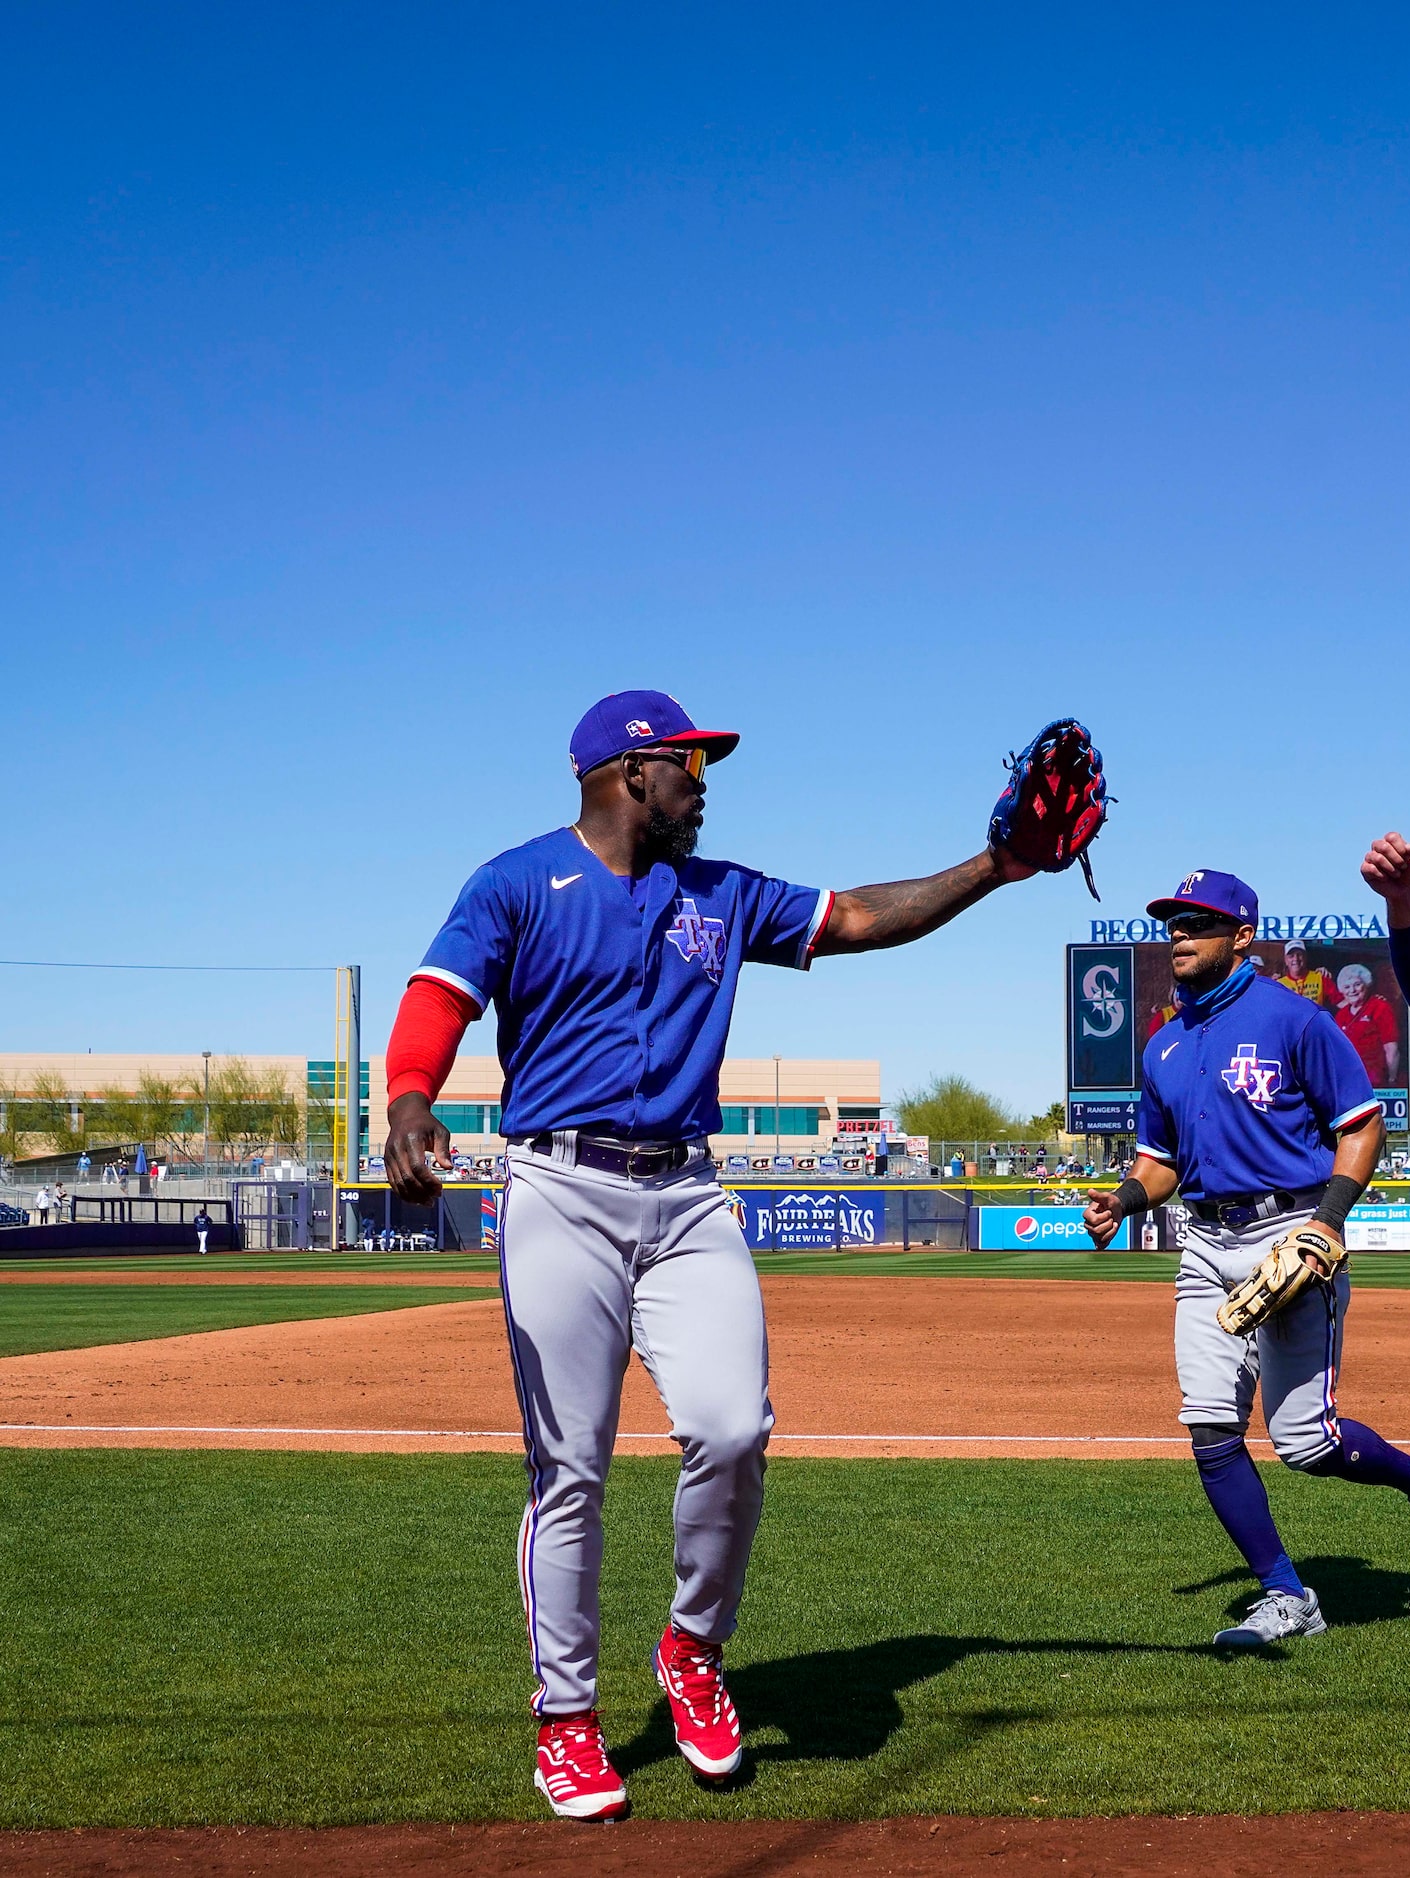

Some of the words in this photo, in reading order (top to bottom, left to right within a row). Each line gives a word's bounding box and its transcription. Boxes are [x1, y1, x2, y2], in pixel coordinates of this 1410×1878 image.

[1180, 872, 1205, 895] T
[1090, 919, 1170, 943] PEOR
[1087, 1106, 1121, 1114] RANGERS
[1126, 1102, 1135, 1114] 4
[836, 1120, 896, 1134] PRETZEL
[1126, 1118, 1135, 1130] 0
[340, 1191, 360, 1201] 340
[1360, 1209, 1387, 1219] grass
[1388, 1208, 1407, 1219] just
[757, 1208, 809, 1242] FOUR
[811, 1208, 875, 1242] PEAKS
[1041, 1222, 1088, 1239] peps
[781, 1234, 832, 1243] BREWING
